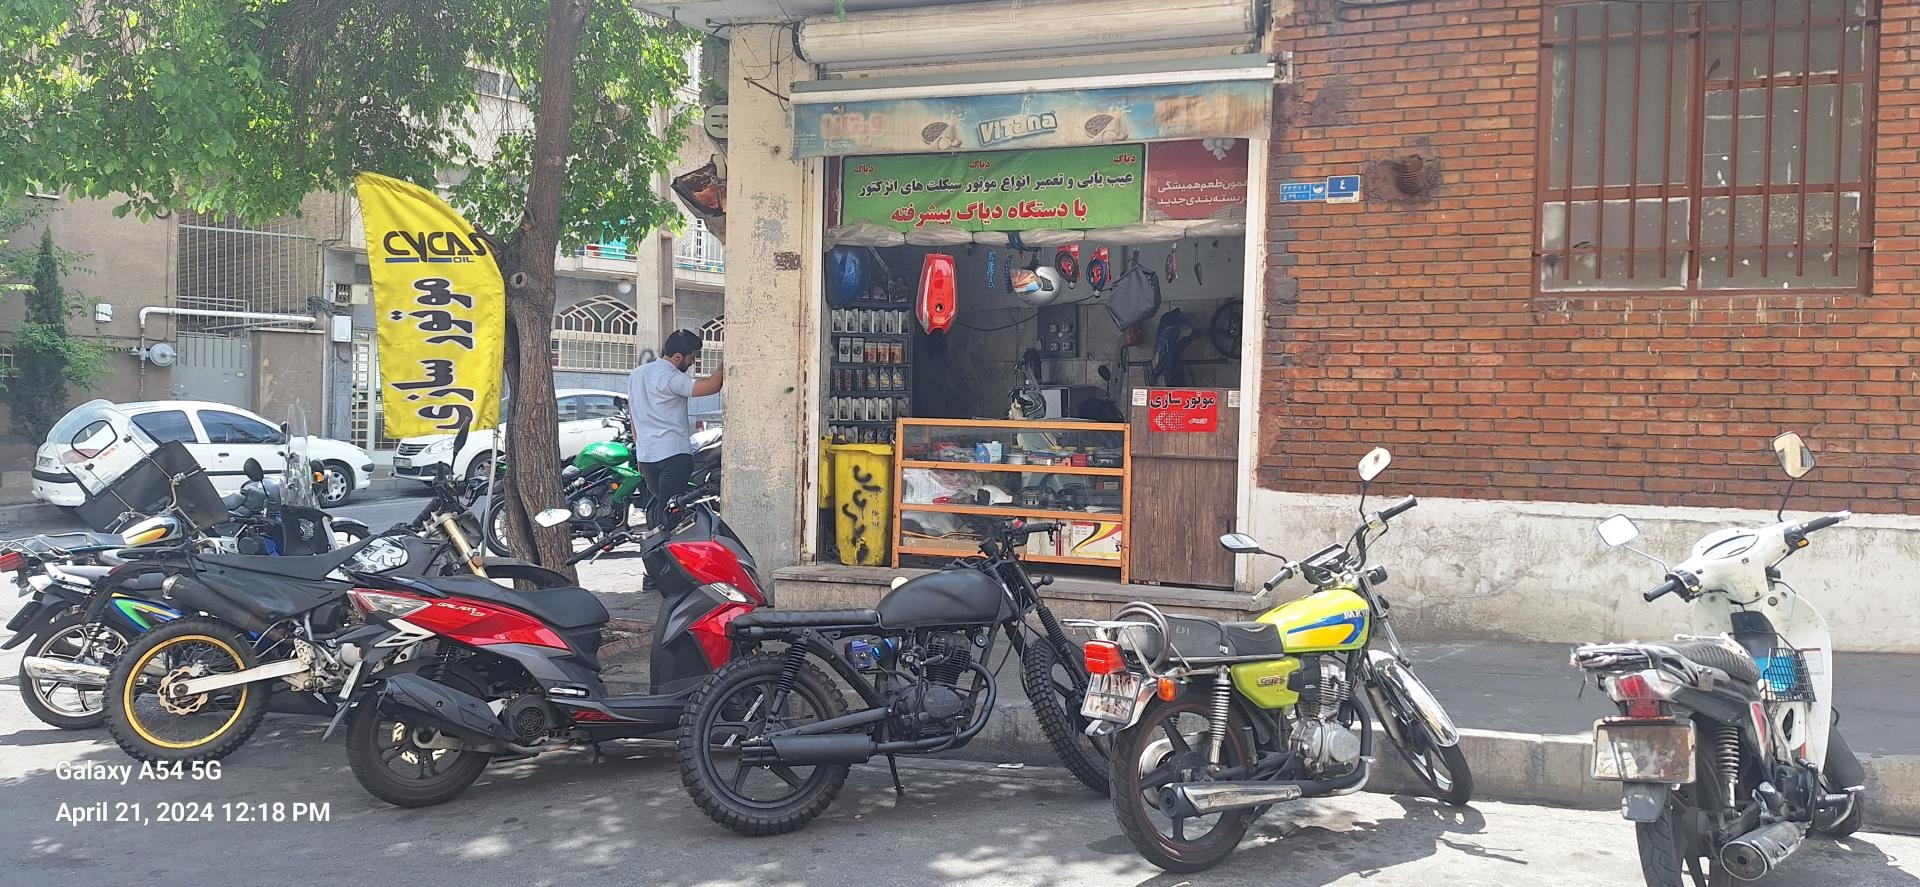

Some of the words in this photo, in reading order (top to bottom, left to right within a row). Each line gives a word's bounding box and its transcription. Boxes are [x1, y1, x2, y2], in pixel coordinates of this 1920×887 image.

[858, 179, 898, 198] انژکتور
[900, 179, 924, 196] های
[926, 177, 961, 193] سیکلت
[964, 174, 998, 193] موتور
[1000, 174, 1030, 192] انواع
[1033, 173, 1064, 191] تعمیر
[1066, 177, 1074, 190] و
[1076, 171, 1103, 189] یابی
[1106, 172, 1133, 186] عیب
[890, 202, 952, 228] پیشرفته
[1007, 199, 1069, 219] دستگاه
[1073, 197, 1088, 222] با
[383, 230, 487, 263] CYCAS
[390, 277, 473, 350] موتور
[391, 359, 474, 431] سازی
[1150, 391, 1181, 410] سازی
[1183, 391, 1216, 409] موتور
